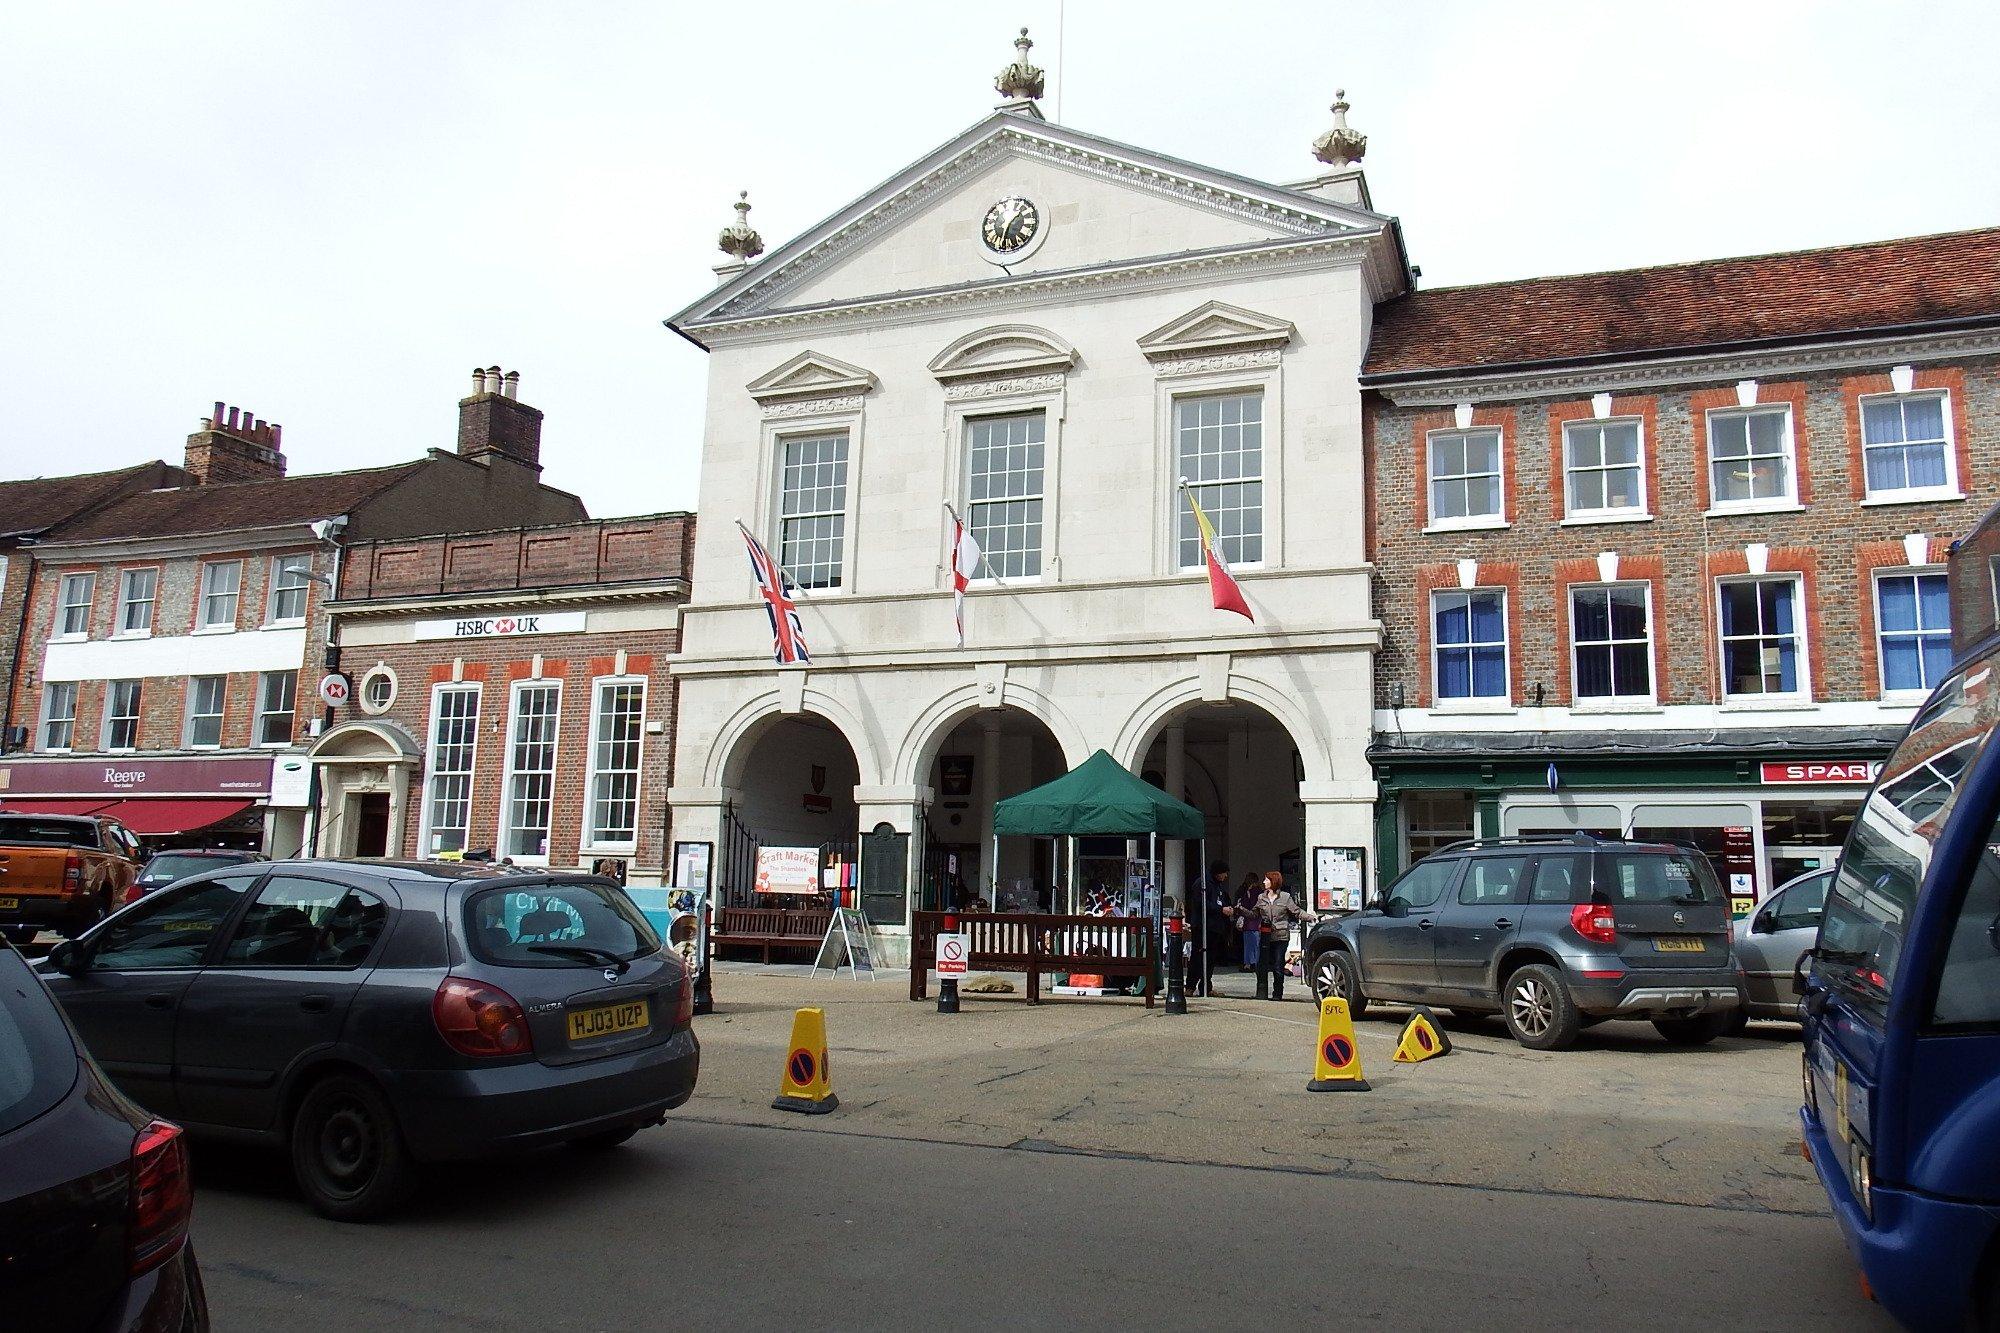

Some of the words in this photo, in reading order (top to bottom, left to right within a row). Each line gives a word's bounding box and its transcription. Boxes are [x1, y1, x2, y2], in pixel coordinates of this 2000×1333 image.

[455, 620, 494, 636] HSBC
[517, 617, 540, 632] UK
[103, 768, 146, 783] Reeve
[1786, 765, 1867, 779] SPAR
[760, 852, 783, 865] Craft
[948, 963, 966, 971] Parking
[528, 1002, 563, 1013] ALMERA
[574, 1010, 614, 1035] HJ03
[616, 1005, 642, 1028] UZP
